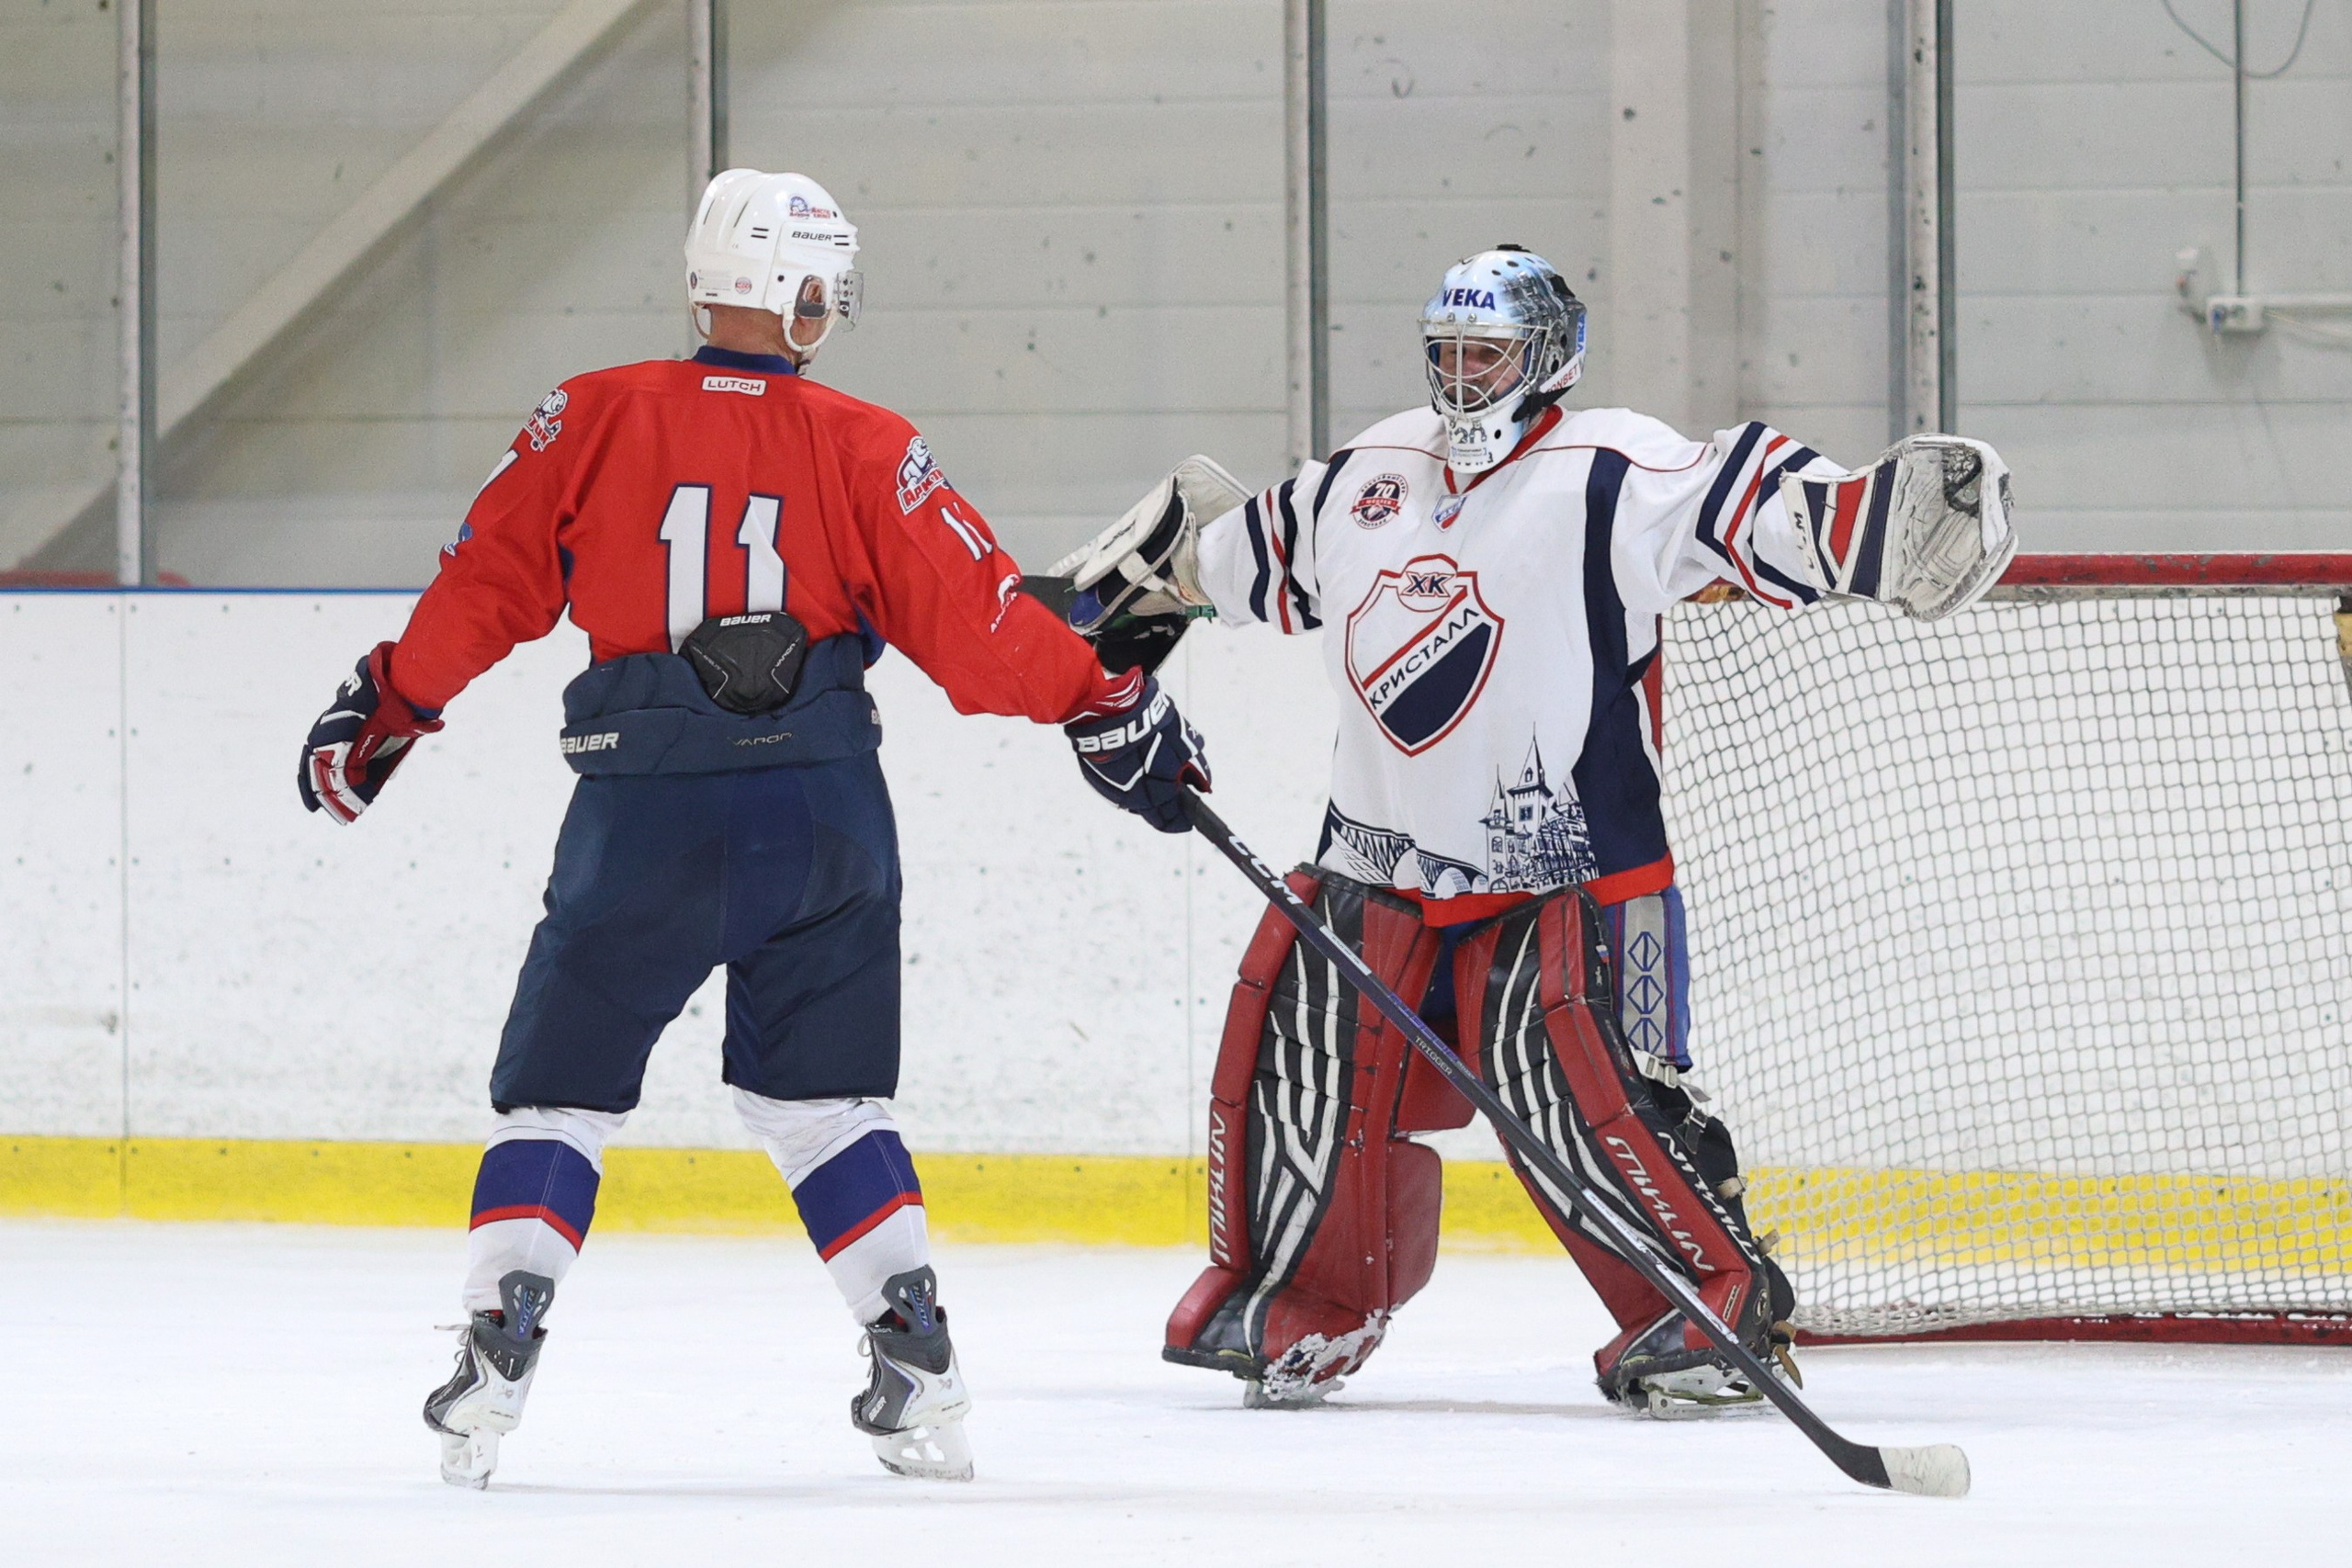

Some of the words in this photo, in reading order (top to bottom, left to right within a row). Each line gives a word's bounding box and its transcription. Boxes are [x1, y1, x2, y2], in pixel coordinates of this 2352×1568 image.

[791, 230, 832, 242] BAUER
[1442, 288, 1496, 311] VEKA
[1577, 314, 1586, 352] VEKA
[707, 379, 762, 392] LUTCH
[1548, 363, 1578, 392] ONBET
[1373, 482, 1396, 498] 70
[658, 483, 786, 654] 11
[1404, 571, 1454, 597] ХК
[719, 613, 773, 627] BAUER
[1369, 607, 1480, 710] КРИСТАЛЛ
[1227, 835, 1304, 905] CCM
[1415, 1034, 1453, 1076] TRIGGER
